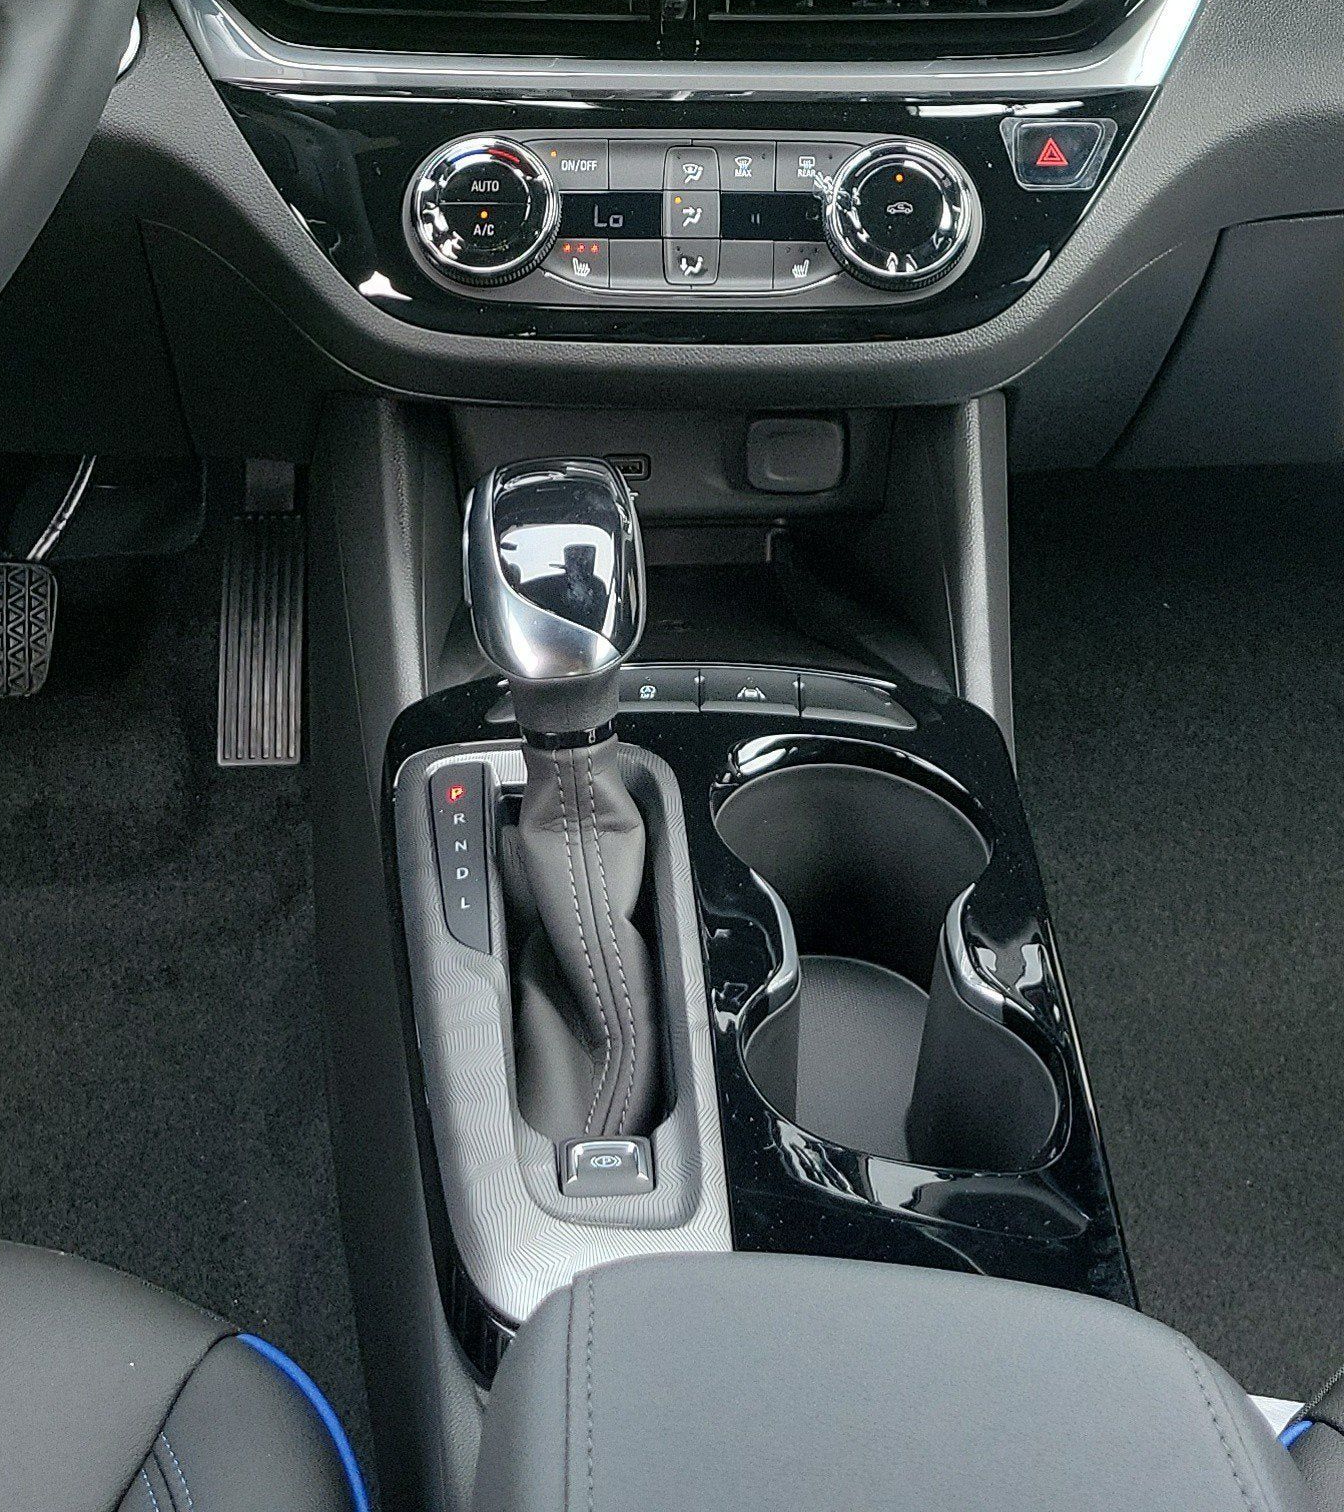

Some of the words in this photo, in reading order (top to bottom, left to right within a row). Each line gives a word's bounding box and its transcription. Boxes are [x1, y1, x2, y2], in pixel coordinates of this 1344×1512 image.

[561, 160, 597, 171] ON/OFF
[734, 169, 752, 177] MAX
[797, 169, 816, 177] REAR
[471, 180, 499, 192] AUTO
[473, 224, 495, 236] A/C
[451, 788, 463, 800] P
[453, 813, 466, 825] R
[455, 839, 467, 852] N
[456, 867, 469, 880] D
[461, 897, 470, 909] L
